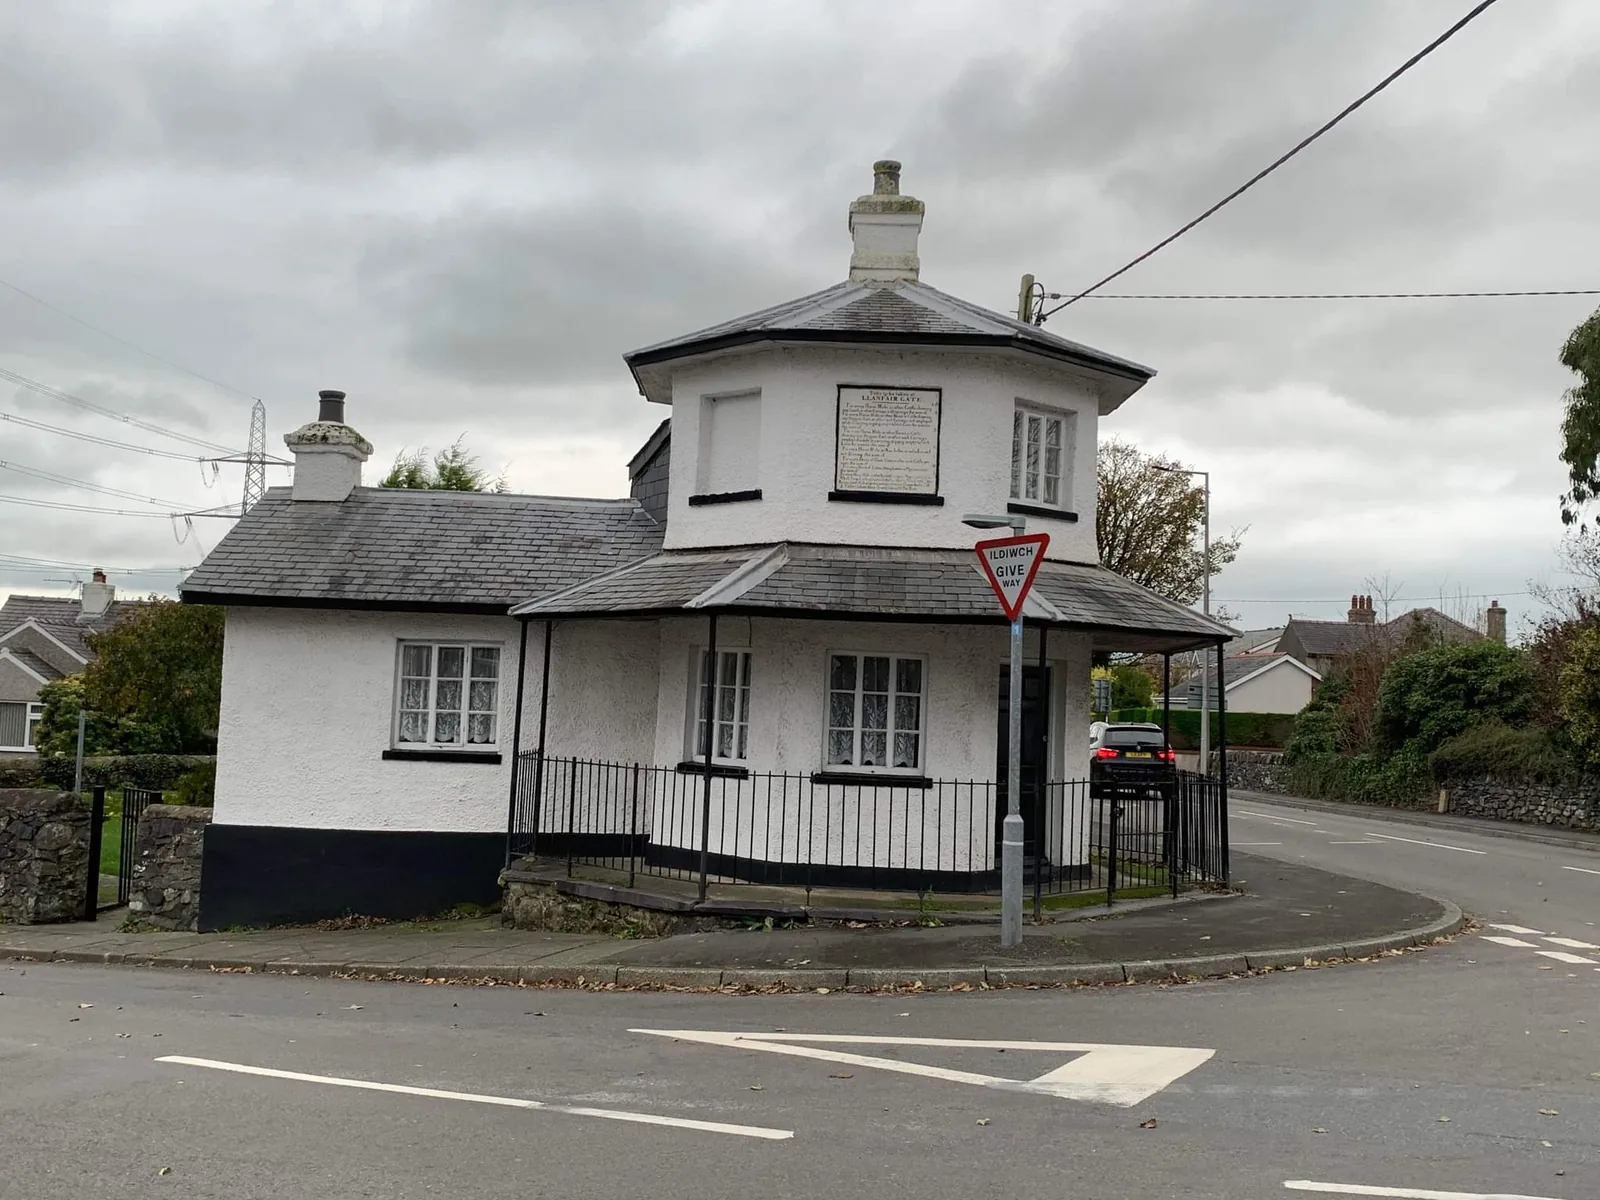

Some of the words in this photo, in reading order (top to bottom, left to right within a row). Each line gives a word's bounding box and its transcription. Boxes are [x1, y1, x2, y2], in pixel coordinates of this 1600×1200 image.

[990, 546, 1033, 559] ILDIWCH
[996, 564, 1025, 577] GIVE
[1002, 579, 1021, 588] WAY
